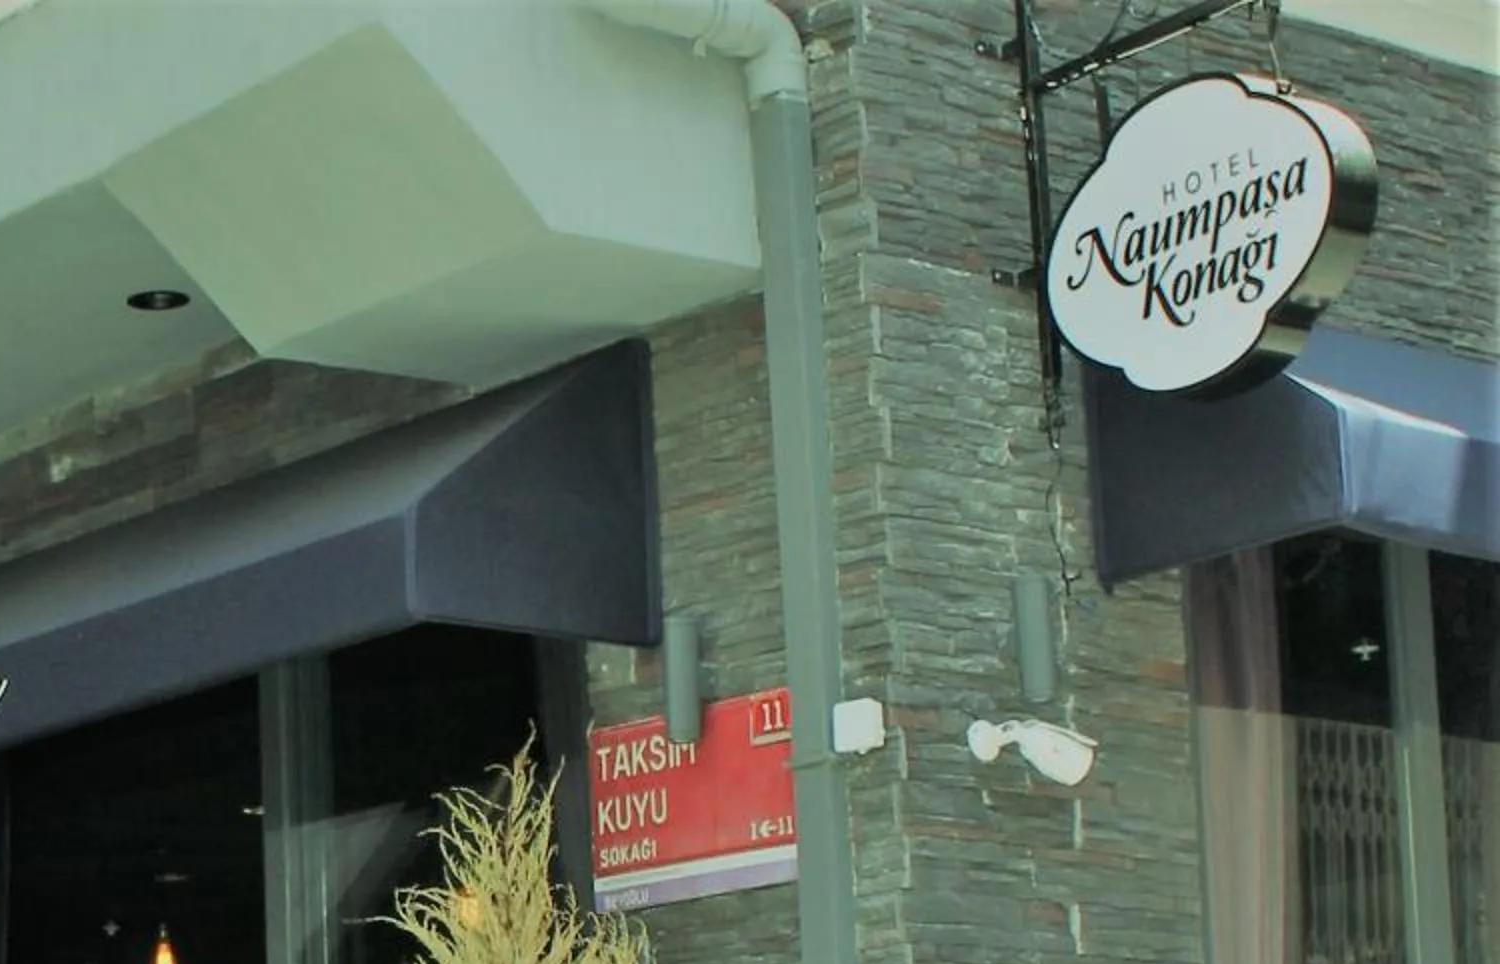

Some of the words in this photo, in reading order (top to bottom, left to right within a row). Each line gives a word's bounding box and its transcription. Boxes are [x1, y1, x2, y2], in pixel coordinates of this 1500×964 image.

[1162, 148, 1260, 205] HOTEL
[1067, 157, 1309, 291] Naumpaşa
[1143, 228, 1279, 327] Konağı
[761, 700, 785, 731] 11
[597, 788, 668, 836] KUYU
[600, 838, 657, 868] SOKAĞI
